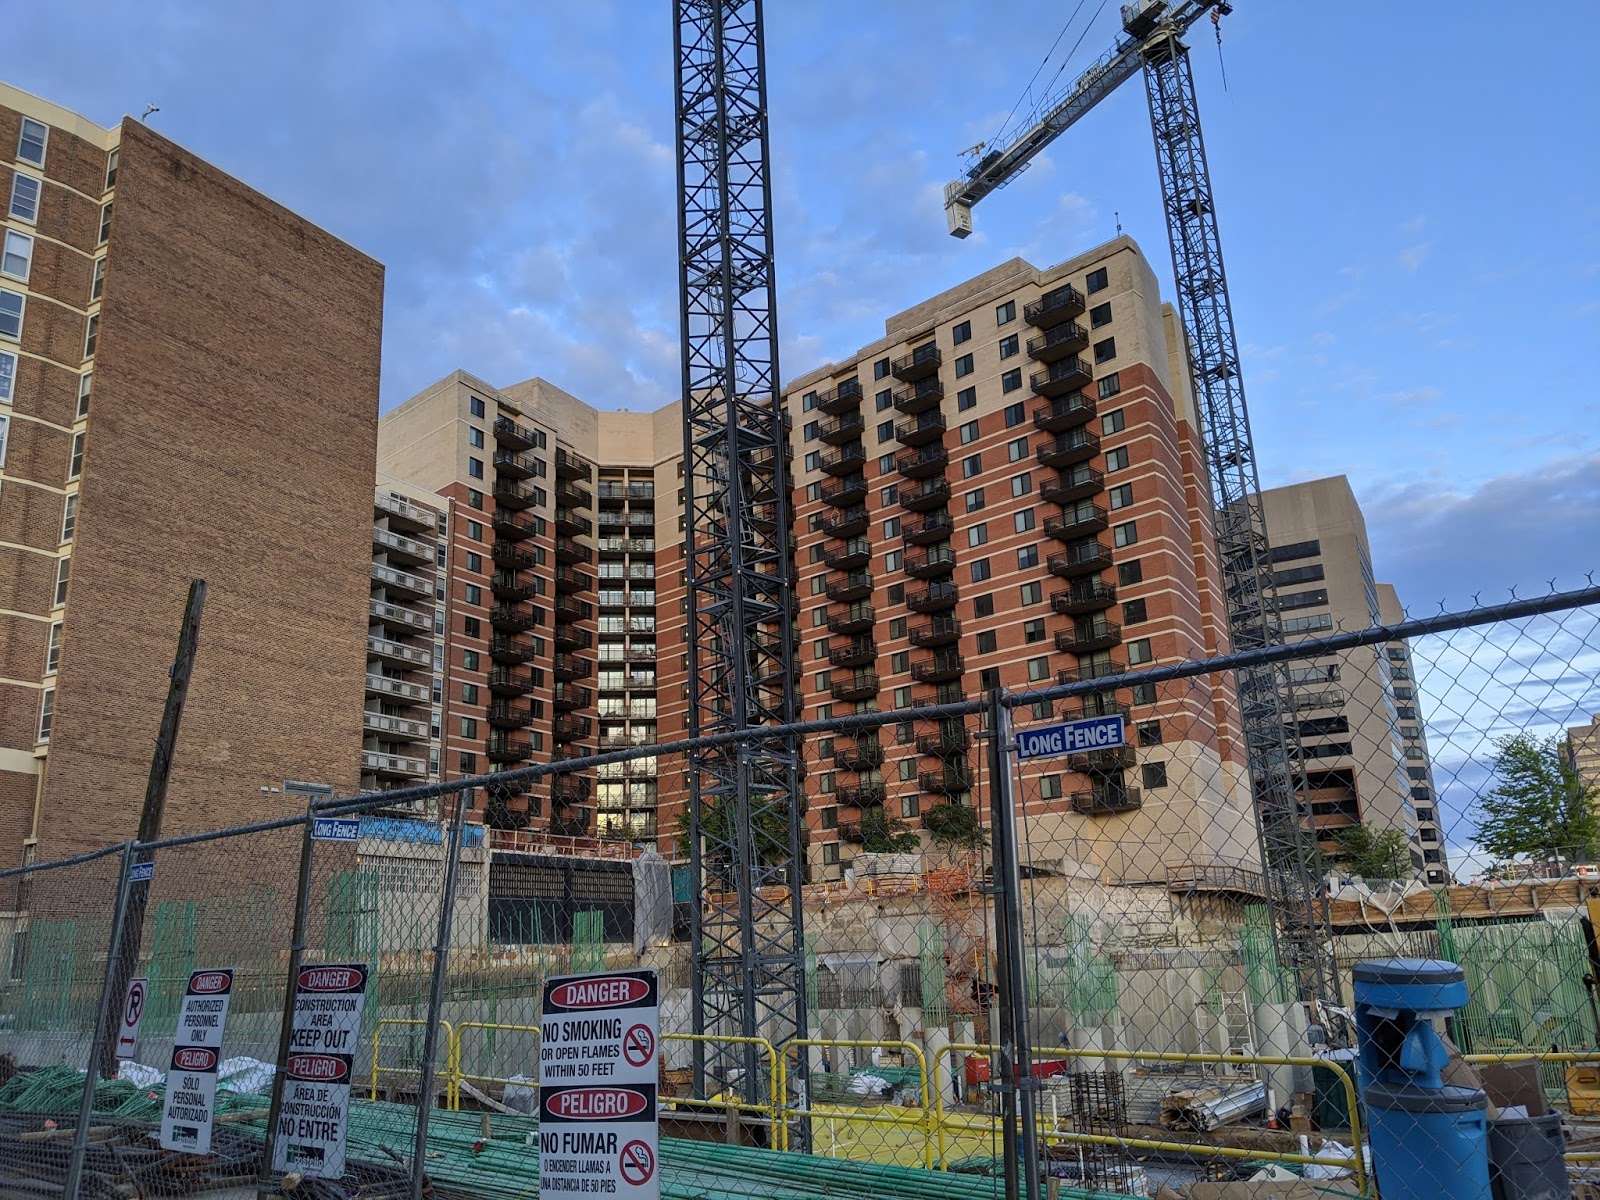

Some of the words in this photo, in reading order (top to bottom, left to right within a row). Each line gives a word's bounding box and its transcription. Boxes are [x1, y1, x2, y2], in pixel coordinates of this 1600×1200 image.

[1019, 733, 1062, 757] LONG
[1064, 724, 1119, 750] FENCE
[332, 821, 358, 838] FENCE
[196, 976, 223, 990] DANGER
[308, 971, 350, 987] DANGER
[566, 981, 630, 1005] DANGER
[185, 1000, 224, 1013] AUTHORIZED
[294, 999, 357, 1012] CONSTRUCTION
[184, 1014, 219, 1027] PERSONNEL
[310, 1014, 333, 1027] AREA
[190, 1029, 208, 1042] ONLY
[290, 1029, 322, 1047] KEEP
[324, 1029, 350, 1049] OUT
[542, 1022, 559, 1043] NO
[562, 1018, 622, 1042] SMOKING
[180, 1052, 209, 1067] PELIGRO
[541, 1048, 553, 1061] OR
[555, 1046, 579, 1060] OPEN
[581, 1044, 620, 1059] FLAMES
[293, 1058, 337, 1077] PELIGRO
[544, 1064, 576, 1078] WITHIN
[577, 1063, 590, 1077] 50
[591, 1062, 615, 1076] FEET
[182, 1073, 200, 1091] SÓLO
[172, 1091, 206, 1107] PERSONAL
[293, 1085, 315, 1101] ÁREA
[317, 1089, 329, 1102] DE
[281, 1102, 341, 1119] CONSTRUCCIÓN
[560, 1092, 628, 1114] PELIGRO
[167, 1106, 209, 1123] AUTORIZADO
[279, 1116, 295, 1137] NO
[298, 1118, 339, 1142] ENTRE
[540, 1132, 559, 1154] NO
[563, 1132, 618, 1154] FUMAR
[544, 1159, 548, 1172] O
[549, 1159, 577, 1174] ENCENDER
[578, 1160, 604, 1174] LLAMAS
[605, 1160, 611, 1174] A
[540, 1177, 551, 1191] UNA
[552, 1178, 580, 1192] DISTANCIA
[581, 1179, 590, 1192] DE
[591, 1179, 599, 1193] 50
[600, 1179, 617, 1194] PIES
